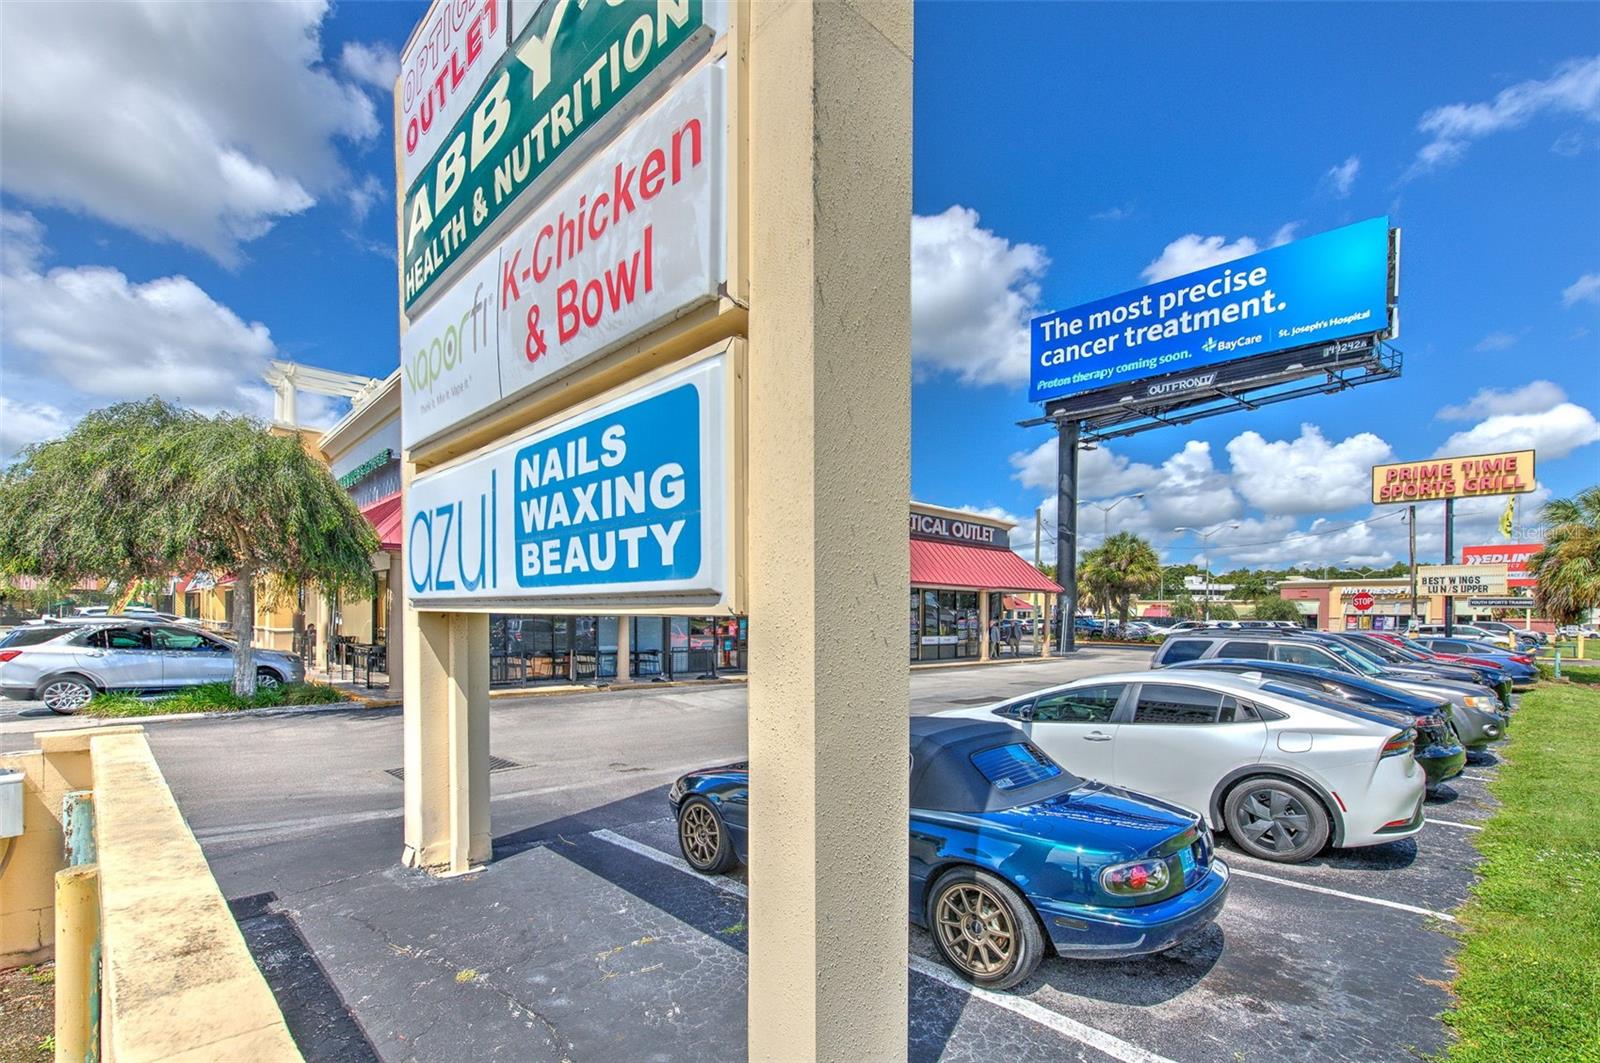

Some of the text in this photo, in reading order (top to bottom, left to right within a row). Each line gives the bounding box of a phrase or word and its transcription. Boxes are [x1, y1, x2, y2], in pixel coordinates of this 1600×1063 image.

[403, 0, 476, 113] OPTIC
[406, 0, 498, 156] OUTLET
[406, 0, 689, 301] HEALTH & NUTRITION
[503, 118, 702, 310] K-Chicken
[525, 225, 653, 363] & Bowl
[1040, 264, 1267, 343] The most precise
[1041, 288, 1287, 367] cancer treatment.
[1278, 308, 1371, 338] St. Joseph's Hospital
[1037, 350, 1192, 391] Proton therapy coming soon.
[1217, 333, 1262, 352] BayCare
[520, 424, 627, 492] NAILS
[1379, 474, 1525, 501] SPORTS GRILL
[1386, 456, 1517, 483] PRIME TIME
[409, 468, 497, 593] azul
[521, 462, 685, 533] WAXING
[952, 521, 995, 542] OUTLET
[522, 519, 686, 577] BEAUTY
[1422, 576, 1445, 585] BEST
[1354, 597, 1373, 606] STOP
